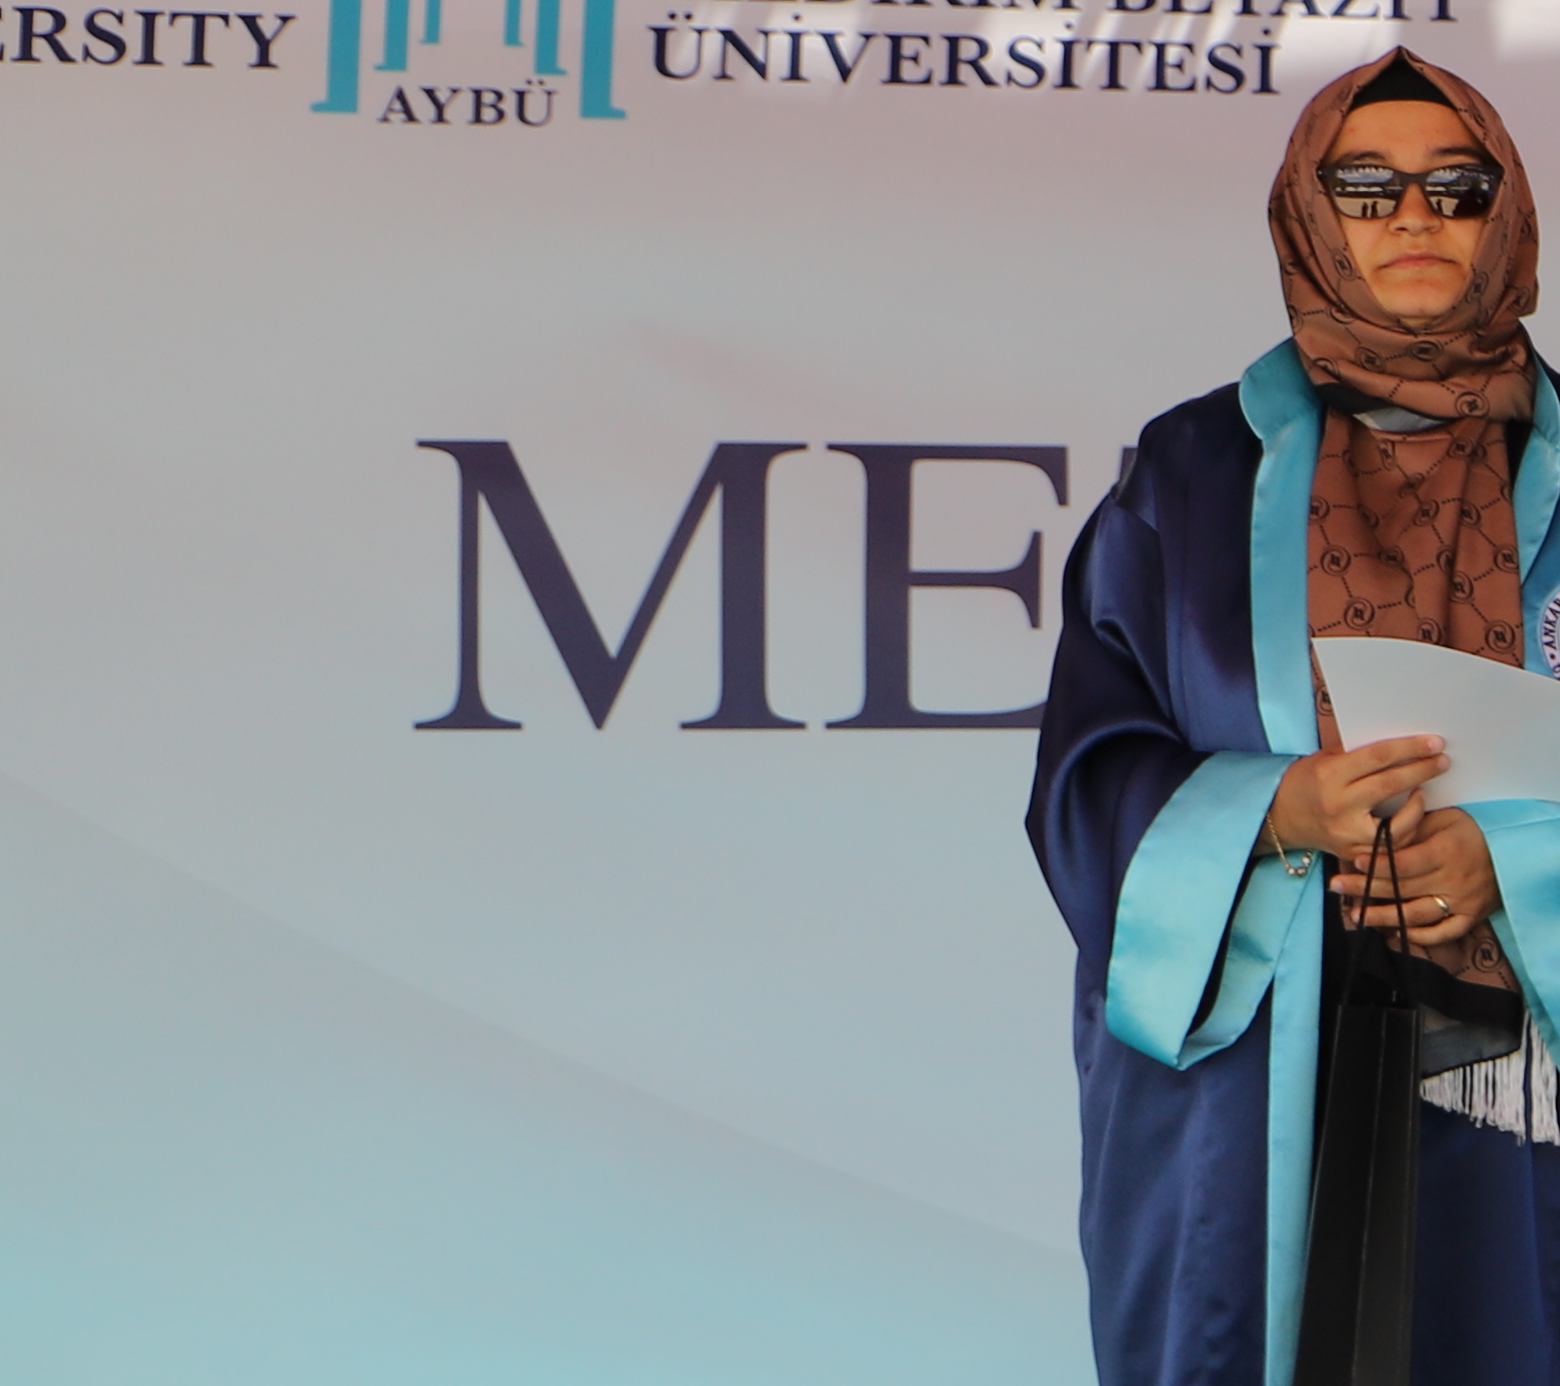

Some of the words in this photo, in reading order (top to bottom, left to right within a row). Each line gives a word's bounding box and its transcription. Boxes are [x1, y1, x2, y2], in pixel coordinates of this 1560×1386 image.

[0, 5, 298, 70] RSITY
[646, 10, 1282, 96] ÜNİVERSİTESİ
[376, 78, 559, 128] AYBÜ
